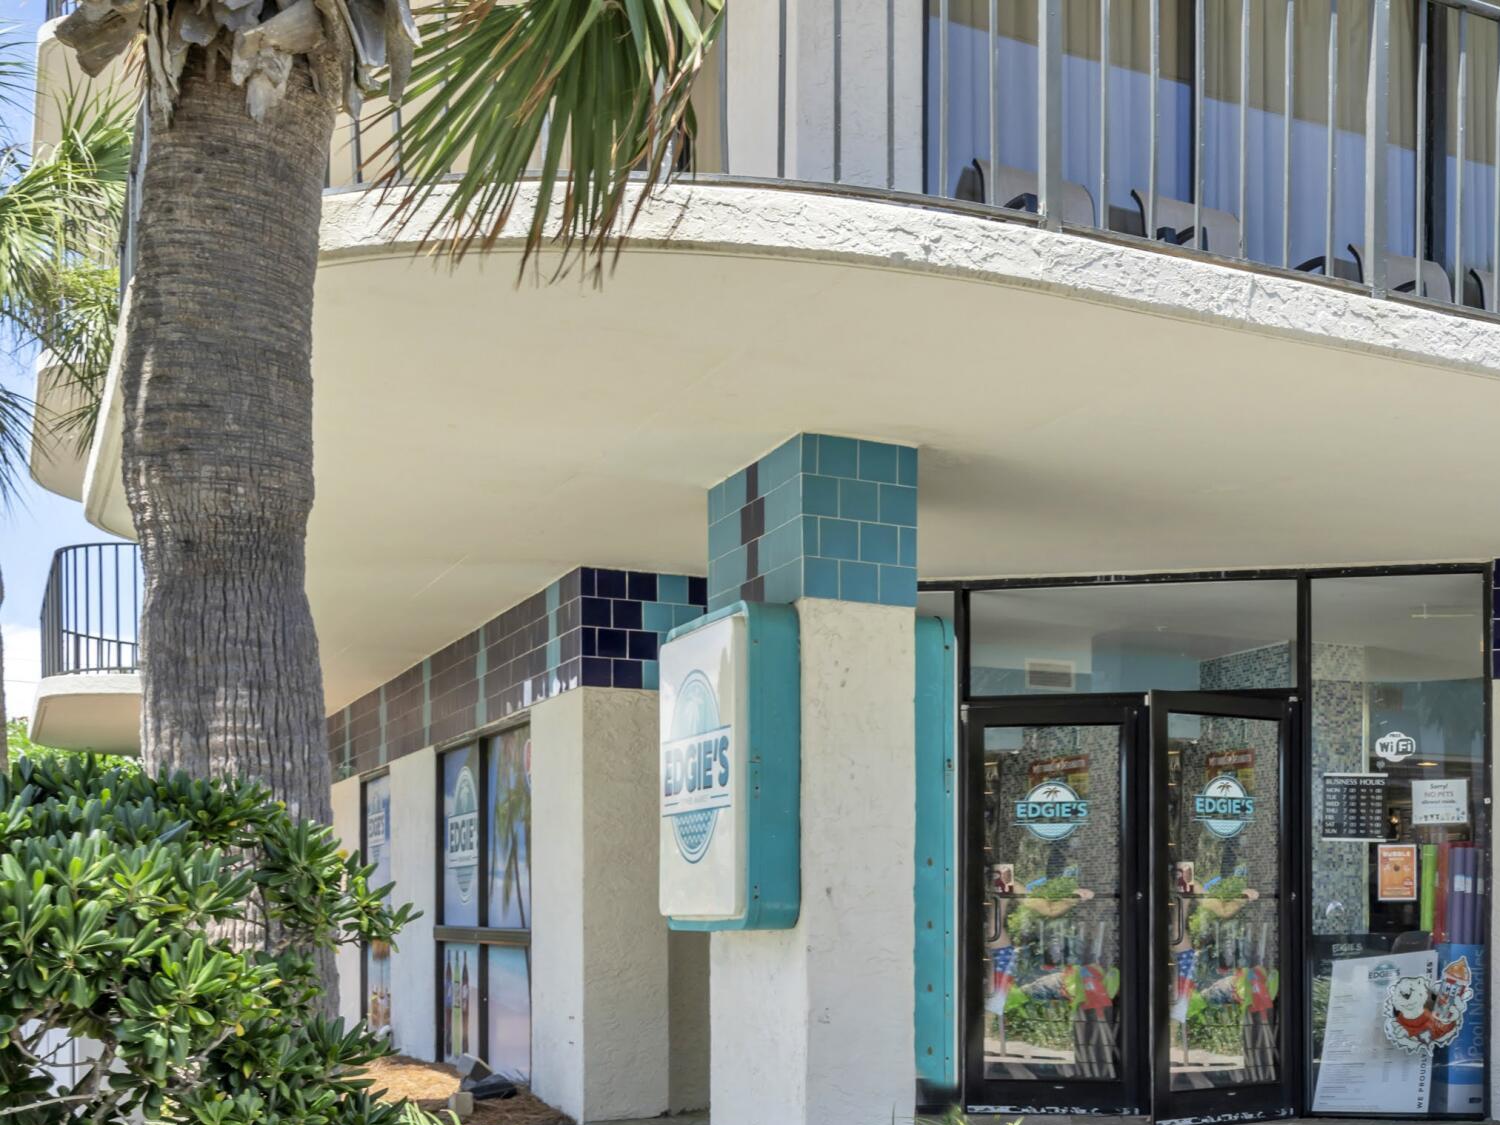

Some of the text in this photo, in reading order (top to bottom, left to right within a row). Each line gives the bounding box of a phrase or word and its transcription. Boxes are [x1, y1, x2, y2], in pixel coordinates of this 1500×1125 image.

[664, 735, 729, 797] EDGIE'S
[1016, 802, 1088, 818] EDGIE'S
[1196, 797, 1254, 815] EDGIE'S
